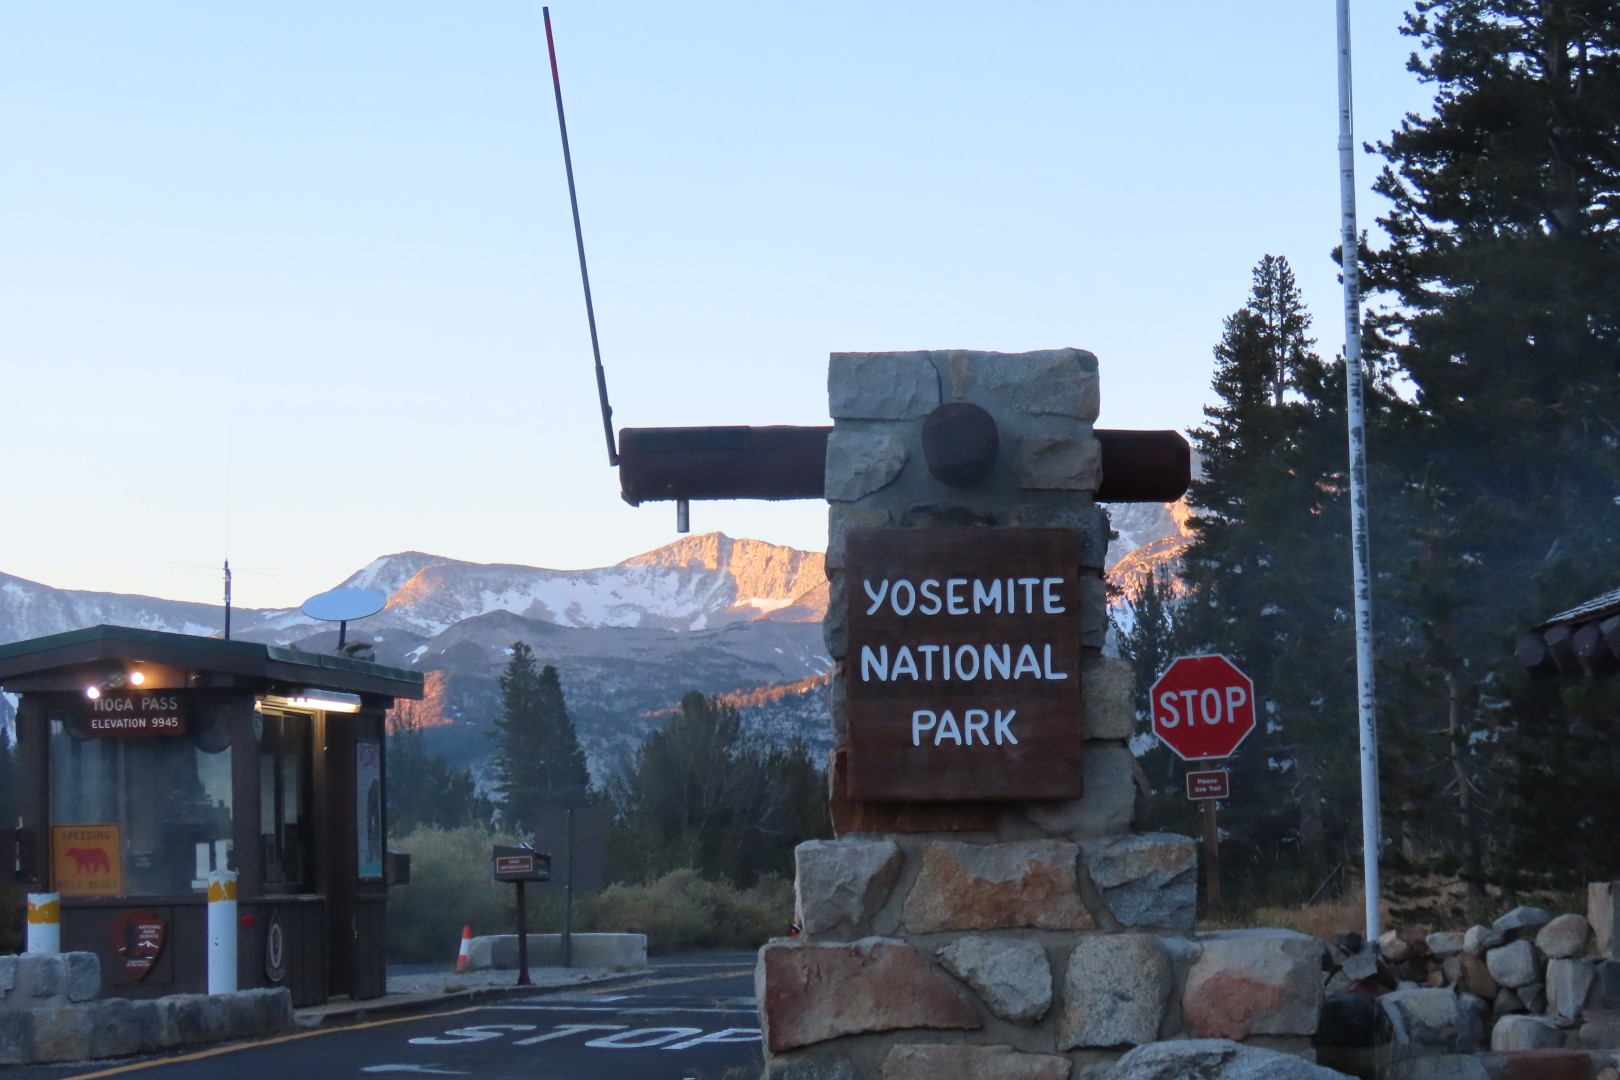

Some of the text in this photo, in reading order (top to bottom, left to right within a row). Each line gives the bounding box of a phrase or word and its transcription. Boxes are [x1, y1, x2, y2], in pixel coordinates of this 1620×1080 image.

[863, 577, 1066, 616] YOSEMITE
[861, 643, 1068, 682] NATIONAL
[93, 697, 178, 712] TIOGA PASS
[1159, 686, 1246, 729] STOP
[91, 717, 178, 729] ELEVATION 9945
[912, 709, 1019, 747] PARK
[62, 830, 111, 840] SPEEDING
[407, 1024, 763, 1050] STOP
